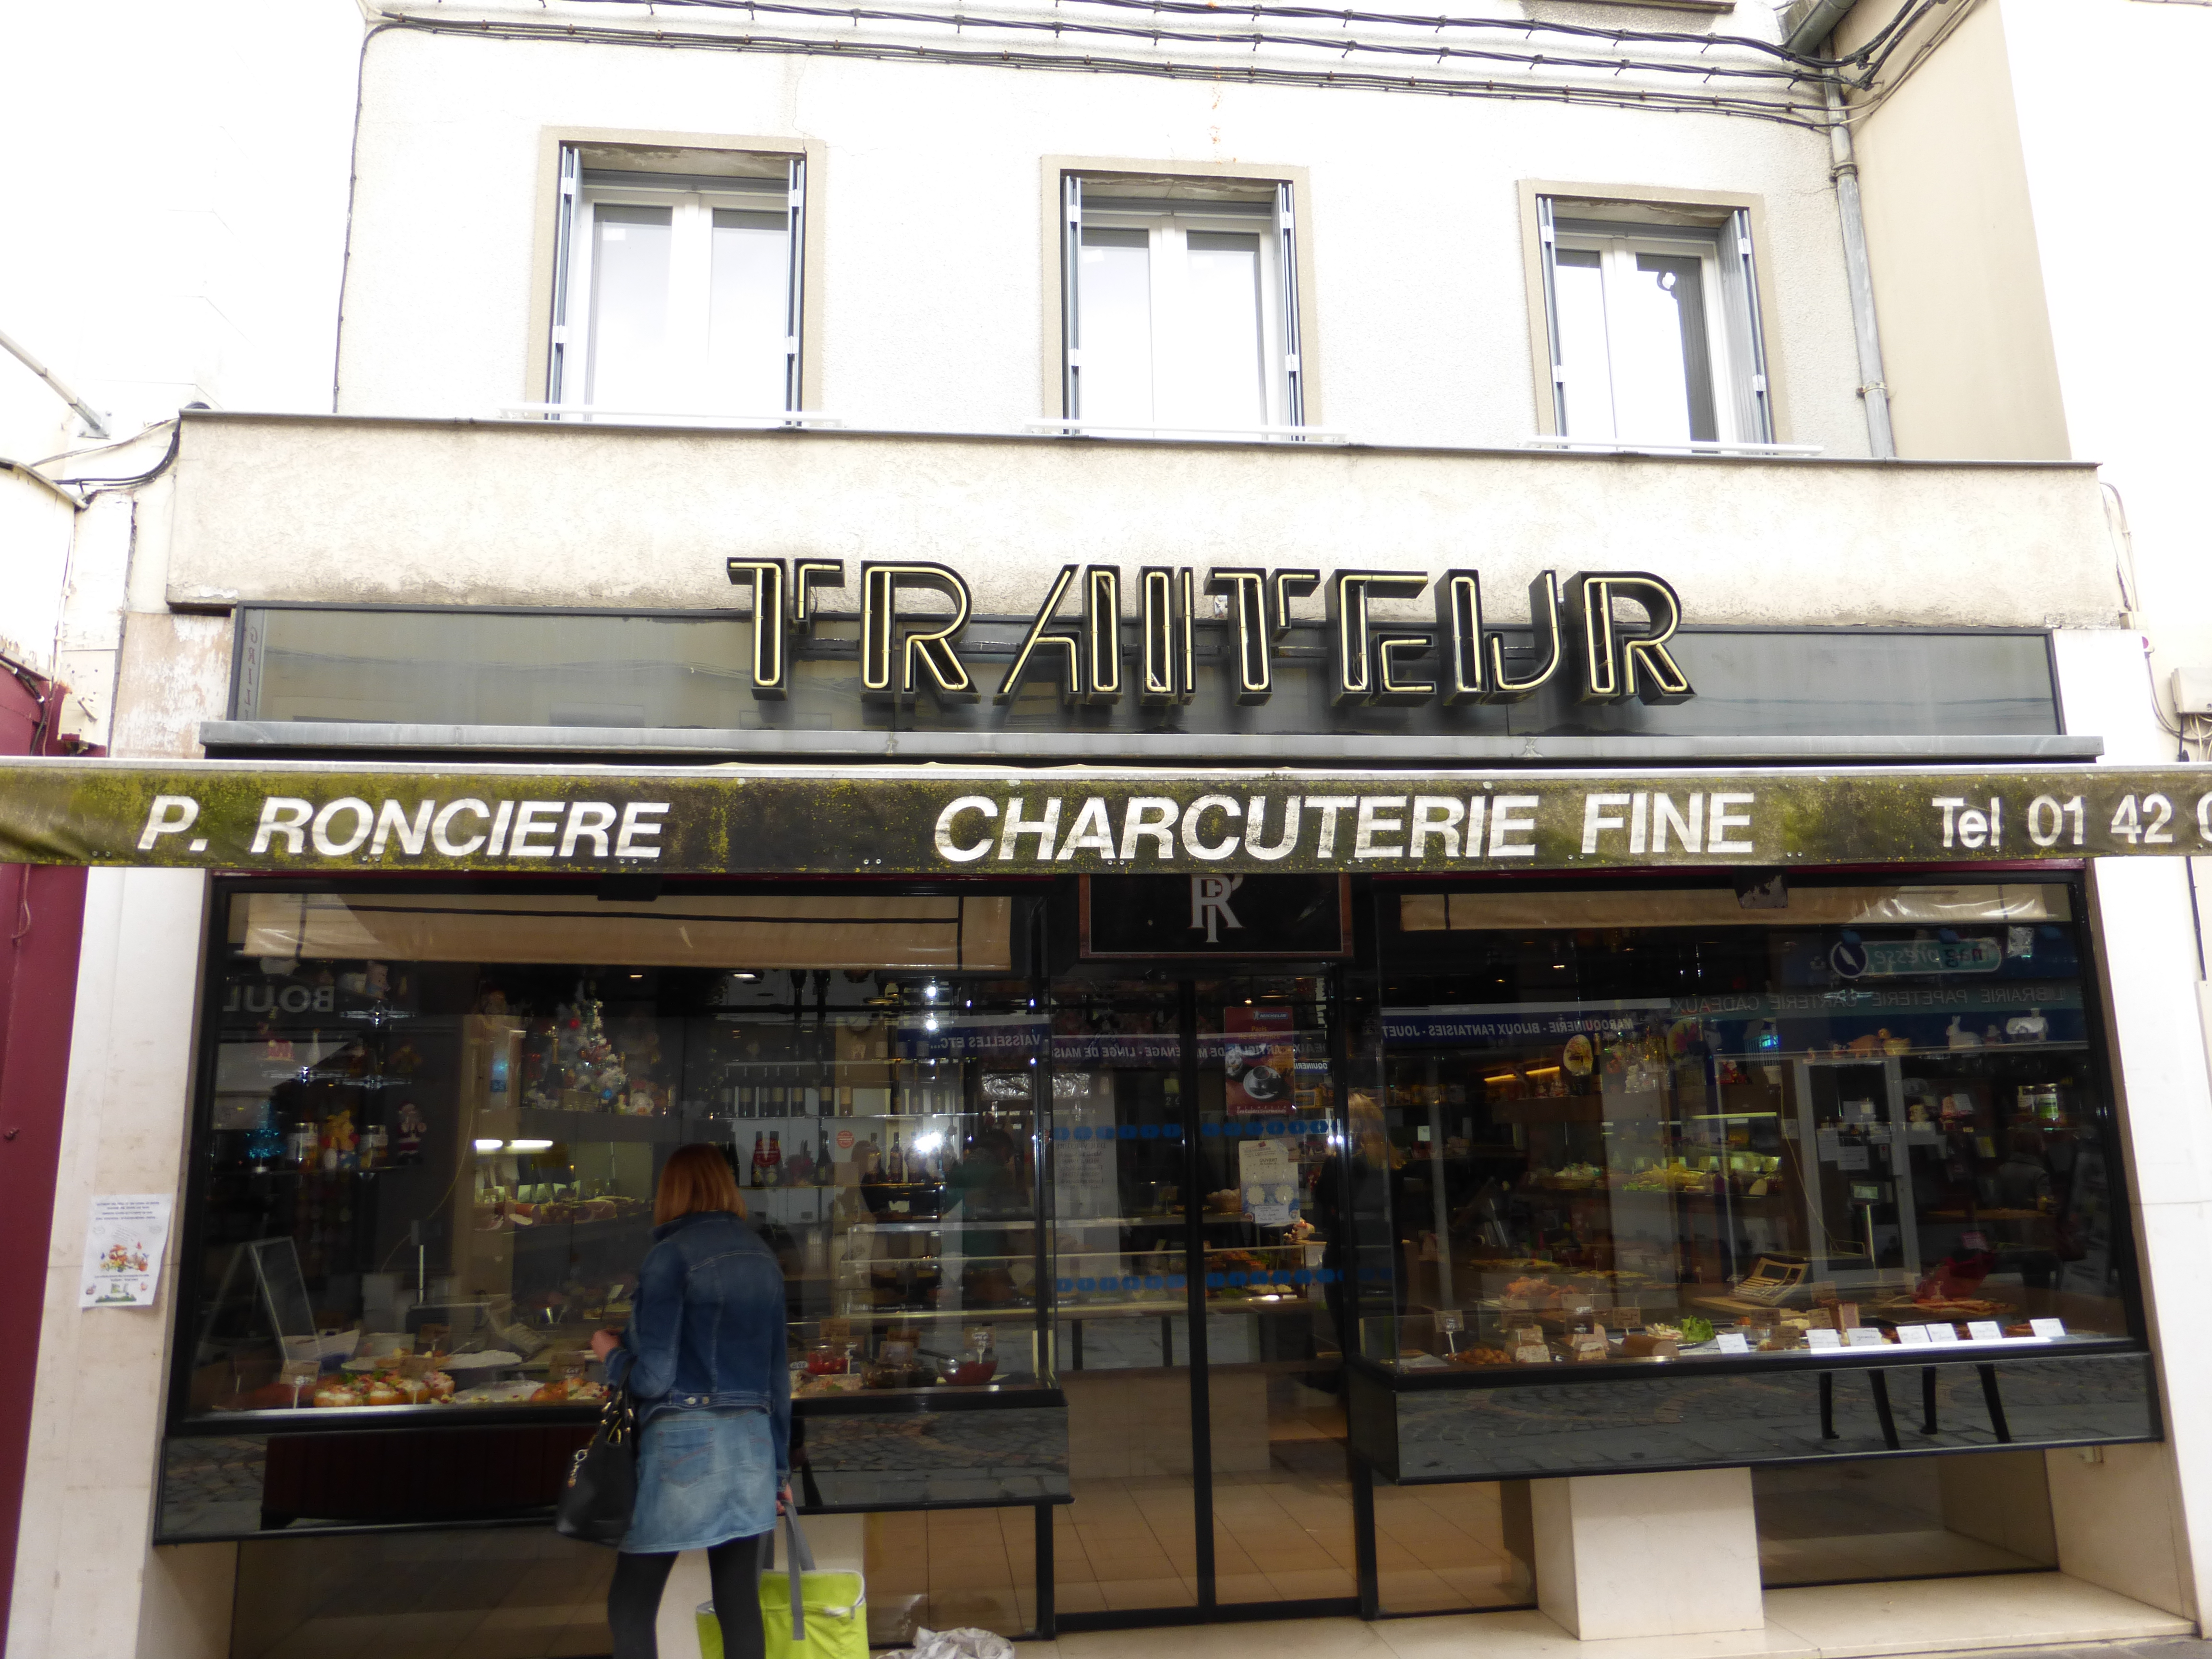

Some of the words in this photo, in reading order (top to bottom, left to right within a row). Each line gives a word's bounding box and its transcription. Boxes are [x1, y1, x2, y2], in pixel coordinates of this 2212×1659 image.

[728, 558, 1696, 706] TRAITEUR
[137, 794, 208, 853] P.
[250, 796, 671, 860] RONCIERE
[935, 794, 1539, 865] CHARCUTERIE
[1582, 790, 1755, 854] FINE
[1932, 796, 2001, 848] Tel
[2026, 795, 2086, 846] 01
[2109, 792, 2175, 844] 42
